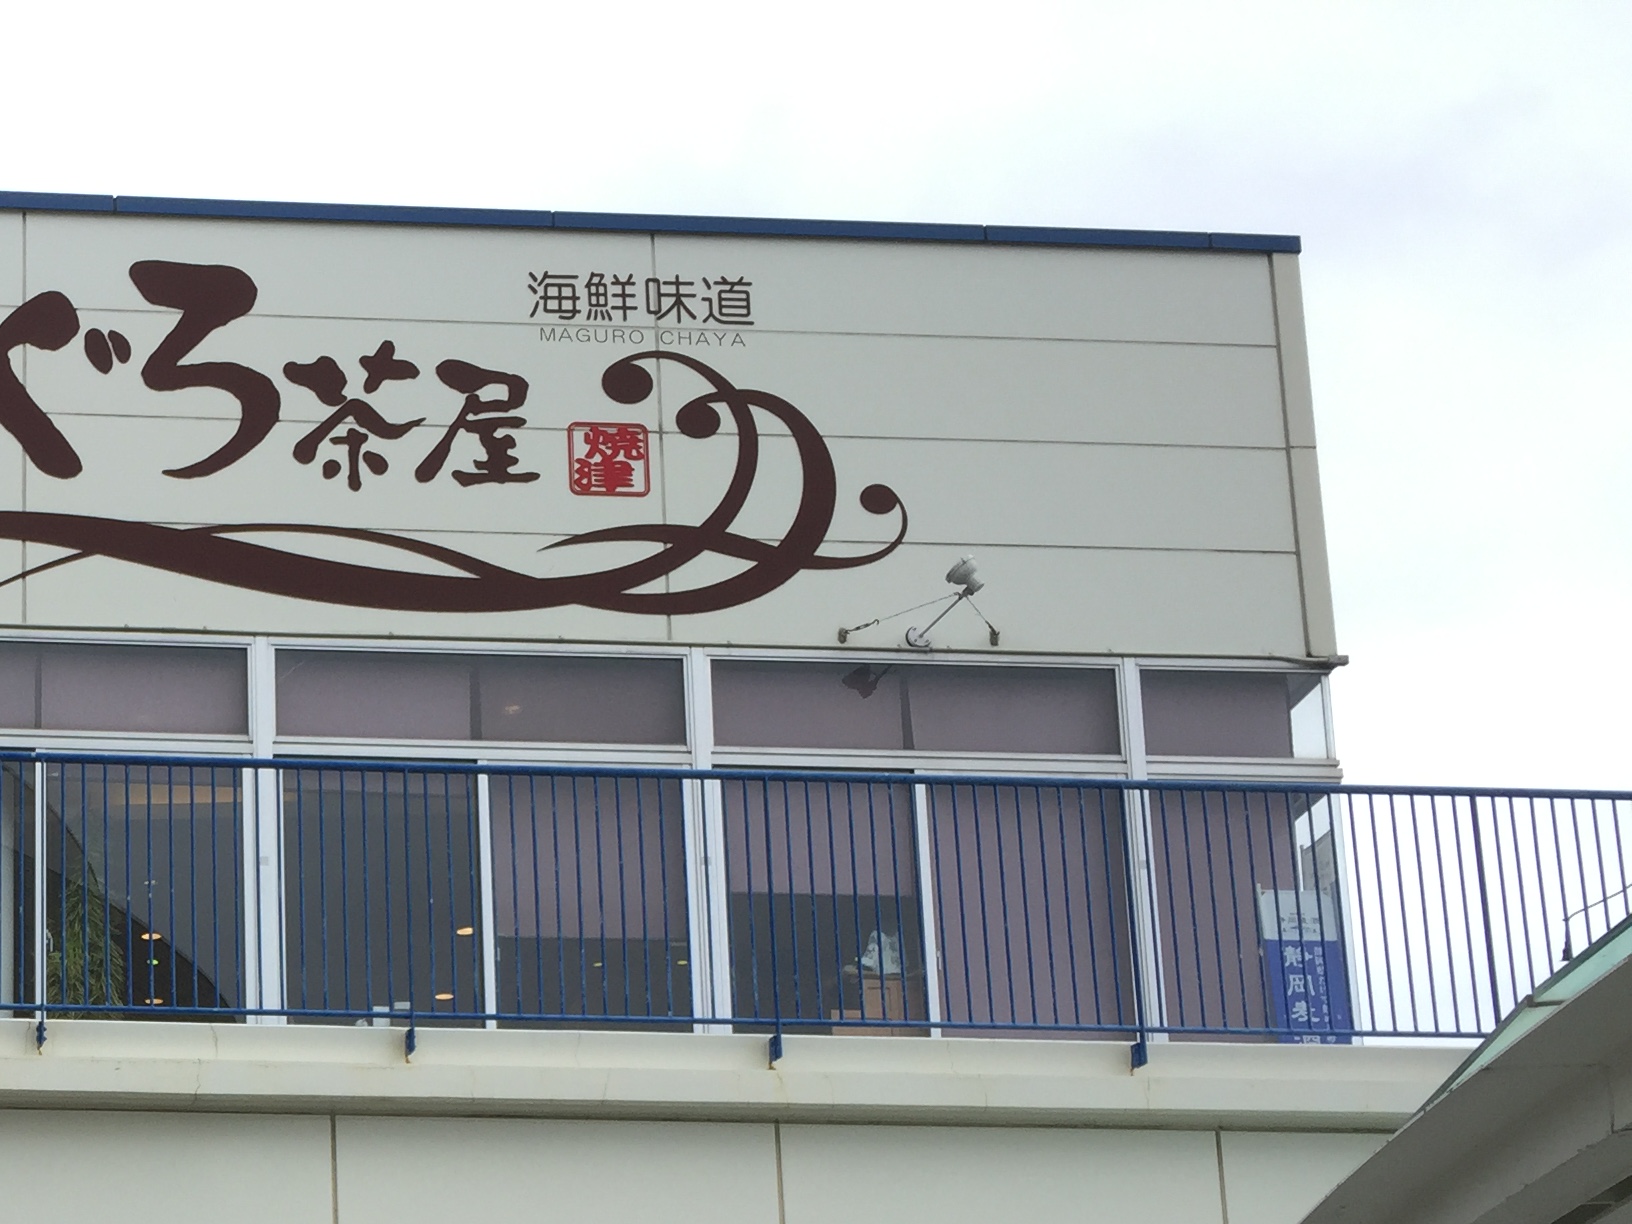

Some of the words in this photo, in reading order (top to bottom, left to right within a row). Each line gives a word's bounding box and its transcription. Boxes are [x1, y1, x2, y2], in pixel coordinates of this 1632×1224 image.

[527, 270, 755, 326] 海鮮味道
[539, 327, 645, 345] MAGURO
[659, 330, 747, 347] CHAYA
